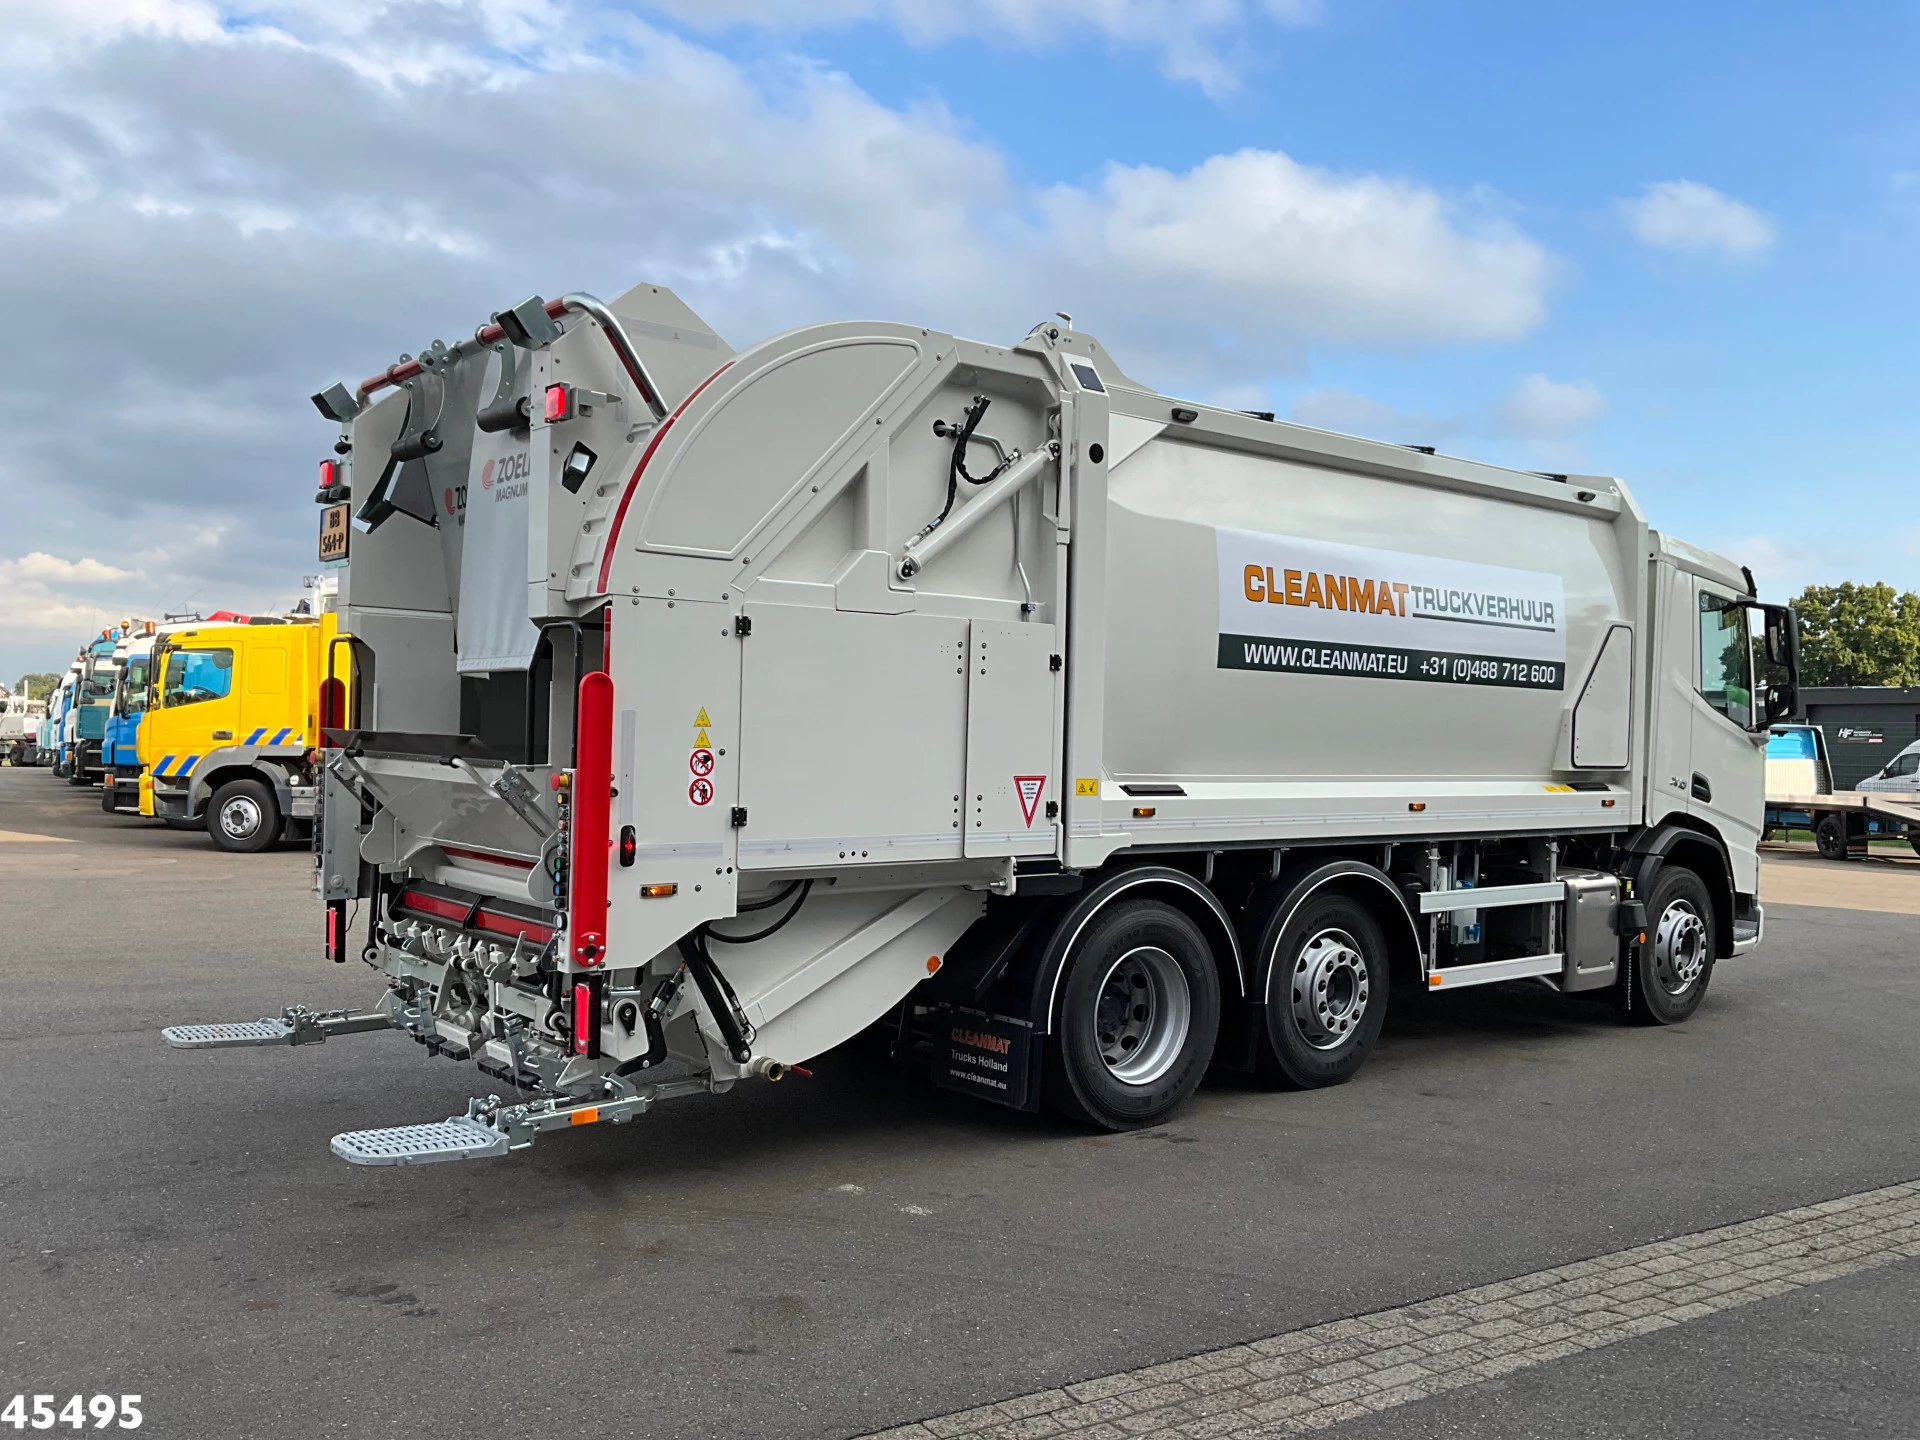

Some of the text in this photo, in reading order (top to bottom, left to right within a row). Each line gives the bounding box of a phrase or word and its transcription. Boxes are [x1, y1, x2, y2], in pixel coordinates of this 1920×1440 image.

[494, 482, 528, 503] MAGNUM
[1243, 564, 1555, 624] CLEANMAT TRUCKVERHUUR
[1243, 643, 1556, 684] WWW.CLEANMAT.EU +31 (0)488 712 600
[951, 1027, 1011, 1055] CLEANMAT
[951, 1049, 1008, 1073] Trucks Holland
[950, 1068, 1007, 1091] www.cleanmat.eu
